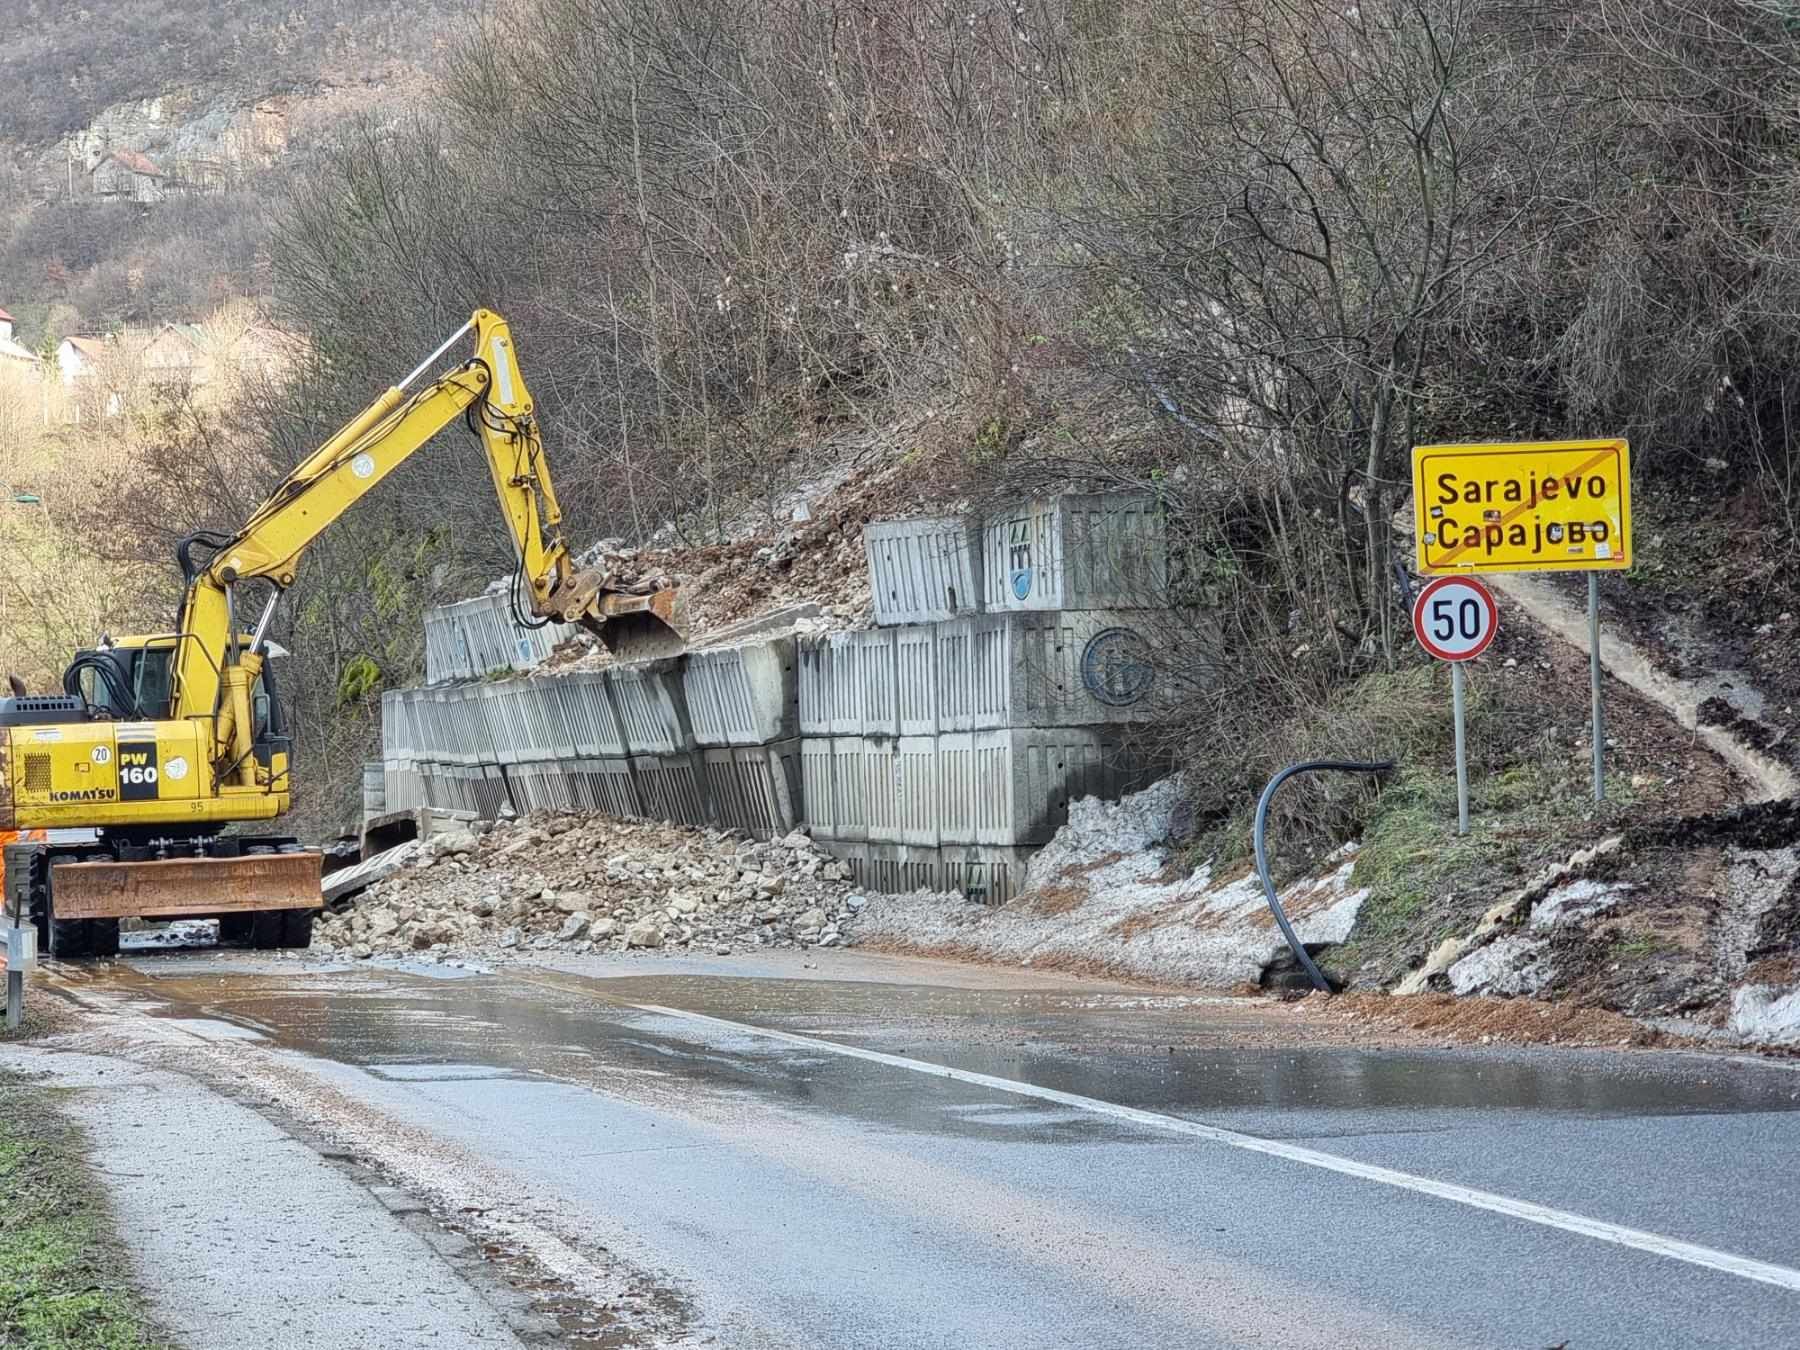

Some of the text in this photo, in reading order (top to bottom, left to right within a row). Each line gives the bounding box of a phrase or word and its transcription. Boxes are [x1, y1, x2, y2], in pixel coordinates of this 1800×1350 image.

[1437, 471, 1606, 509] Sarajevo
[1433, 599, 1480, 640] 50
[95, 748, 107, 761] 20
[120, 753, 147, 766] PW
[119, 767, 158, 784] 160
[50, 787, 115, 802] KOMATSU
